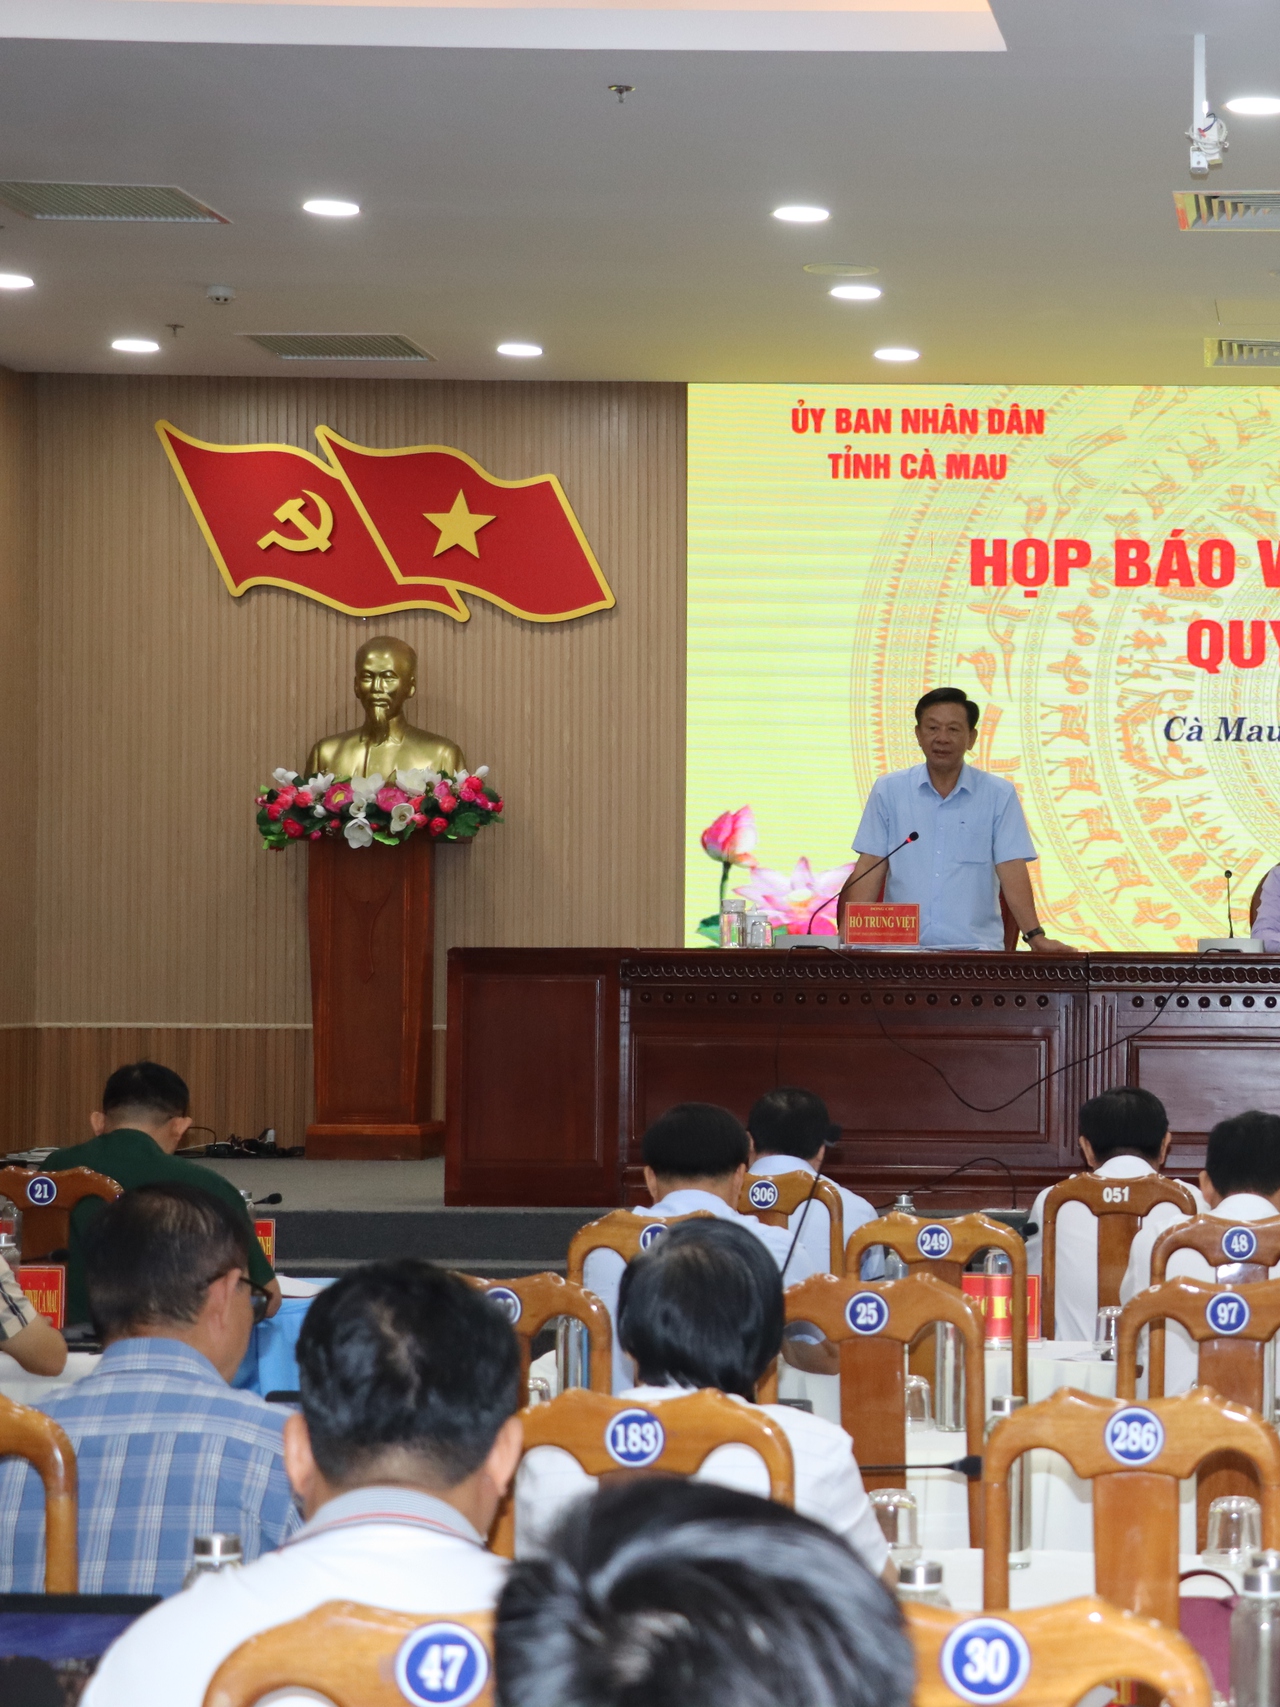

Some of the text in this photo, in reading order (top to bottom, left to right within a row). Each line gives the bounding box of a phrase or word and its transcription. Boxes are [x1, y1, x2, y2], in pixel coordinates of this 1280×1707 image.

[791, 399, 1045, 435] ỦY BAN NHÂN DÂN
[827, 444, 1008, 481] TỈNH CÀ MAU
[970, 537, 1092, 598] HỌP
[1114, 528, 1236, 589] BÁO
[1164, 716, 1203, 742] Cà
[864, 916, 895, 928] TRUNG
[896, 914, 917, 931] VIỆT
[34, 1183, 49, 1199] 21
[752, 1186, 775, 1203] 306
[1102, 1186, 1130, 1203] 051
[921, 1232, 949, 1251] 249
[1230, 1233, 1249, 1253] 48
[856, 1301, 879, 1325] 25
[1216, 1301, 1239, 1325] 97
[614, 1421, 657, 1455] 183
[1111, 1420, 1156, 1454] 286
[417, 1643, 468, 1692] 47
[963, 1636, 1010, 1685] 30
